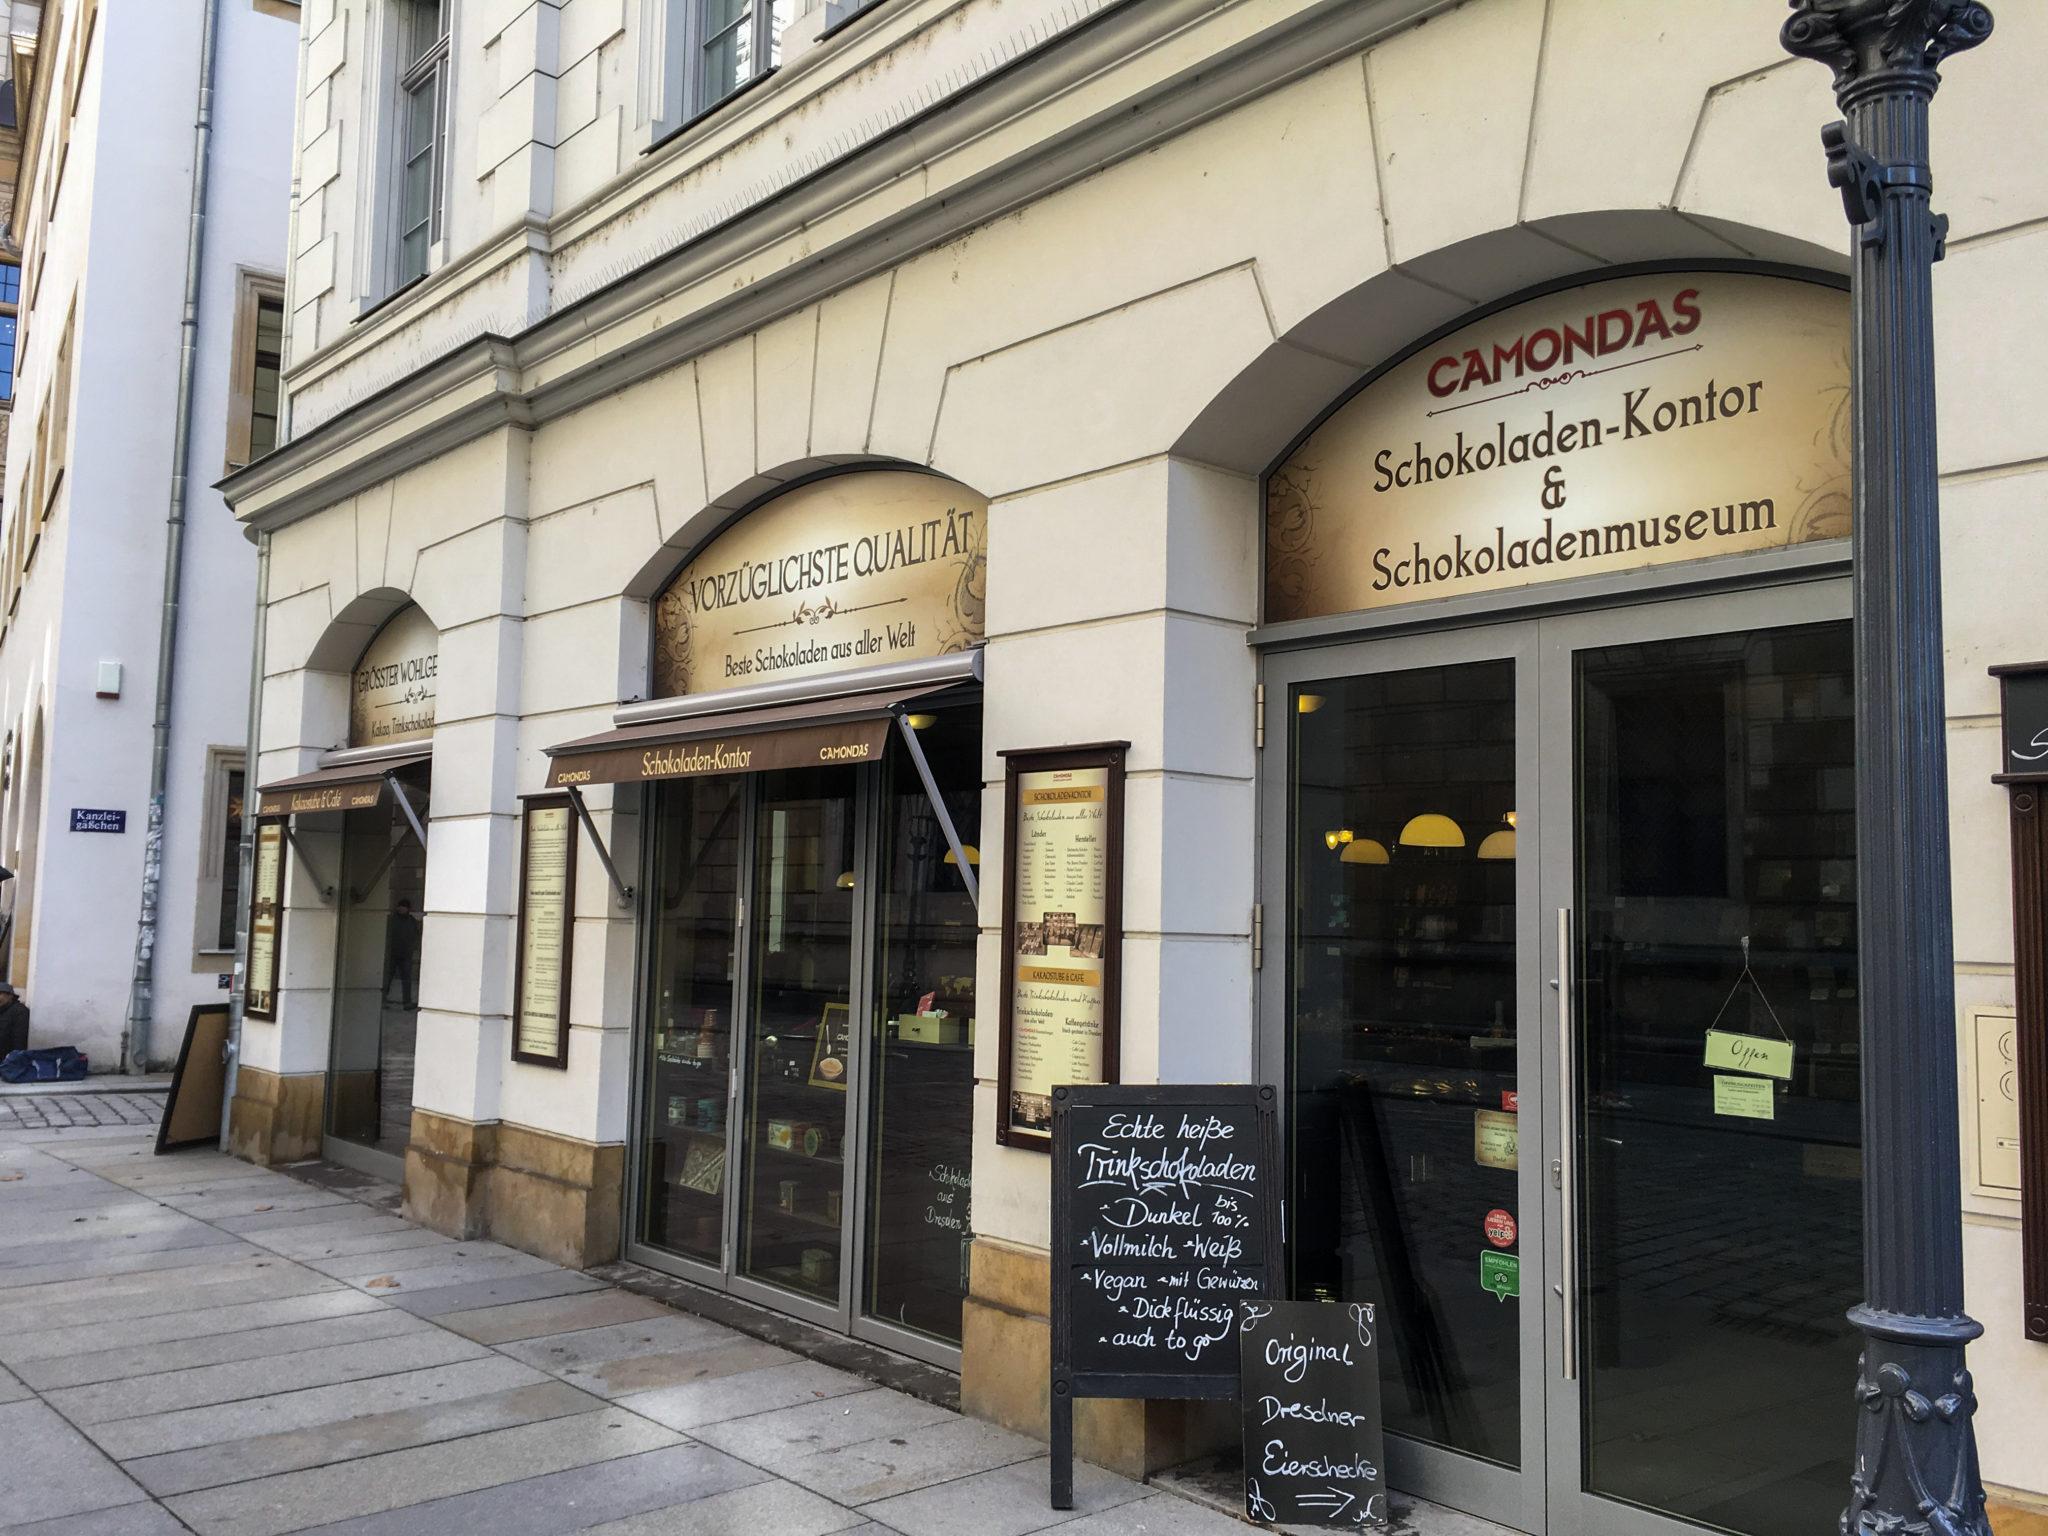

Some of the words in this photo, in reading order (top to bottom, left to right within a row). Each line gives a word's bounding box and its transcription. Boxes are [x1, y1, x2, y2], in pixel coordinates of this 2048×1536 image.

[1426, 288, 1703, 398] CAMONDAS
[1373, 379, 1763, 493] Schokoladen-Kontor
[1540, 466, 1566, 510] &
[690, 541, 849, 613] VORZÜGLICHSTE
[853, 508, 974, 577] QUALITÄT
[1372, 497, 1776, 592] Schokoladenmuseum
[725, 650, 752, 678] Beste
[755, 638, 828, 673] Schokoladen
[831, 640, 852, 660] aus
[855, 628, 883, 655] aller
[886, 621, 916, 651] Welt
[640, 743, 752, 776] Schokoladen-Kontor
[819, 743, 869, 761] CAMONDAS
[557, 769, 591, 784] CAMONDAS
[75, 819, 119, 831] gäßchen
[76, 810, 121, 821] Kanzlei-
[1730, 1039, 1769, 1069] Offen
[1102, 1113, 1165, 1139] Echte
[1176, 1113, 1235, 1151] heiße
[1077, 1143, 1256, 1199] Trinkschokoladen
[936, 1192, 954, 1204] aus
[1102, 1197, 1203, 1228] Dunkel
[1214, 1194, 1238, 1212] bis
[924, 1205, 962, 1230] Dresden
[1488, 1228, 1505, 1238] yelp
[1091, 1230, 1178, 1259] Vollmilch
[1193, 1233, 1242, 1268] Weiß
[1094, 1268, 1148, 1301] Vegan
[1168, 1270, 1189, 1288] mit
[1112, 1326, 1157, 1347] auch
[1165, 1330, 1186, 1350] to
[1185, 1333, 1212, 1361] go
[1265, 1332, 1354, 1383] Original
[1258, 1396, 1366, 1427] Dresdner
[1262, 1439, 1378, 1481] Eierschecke
